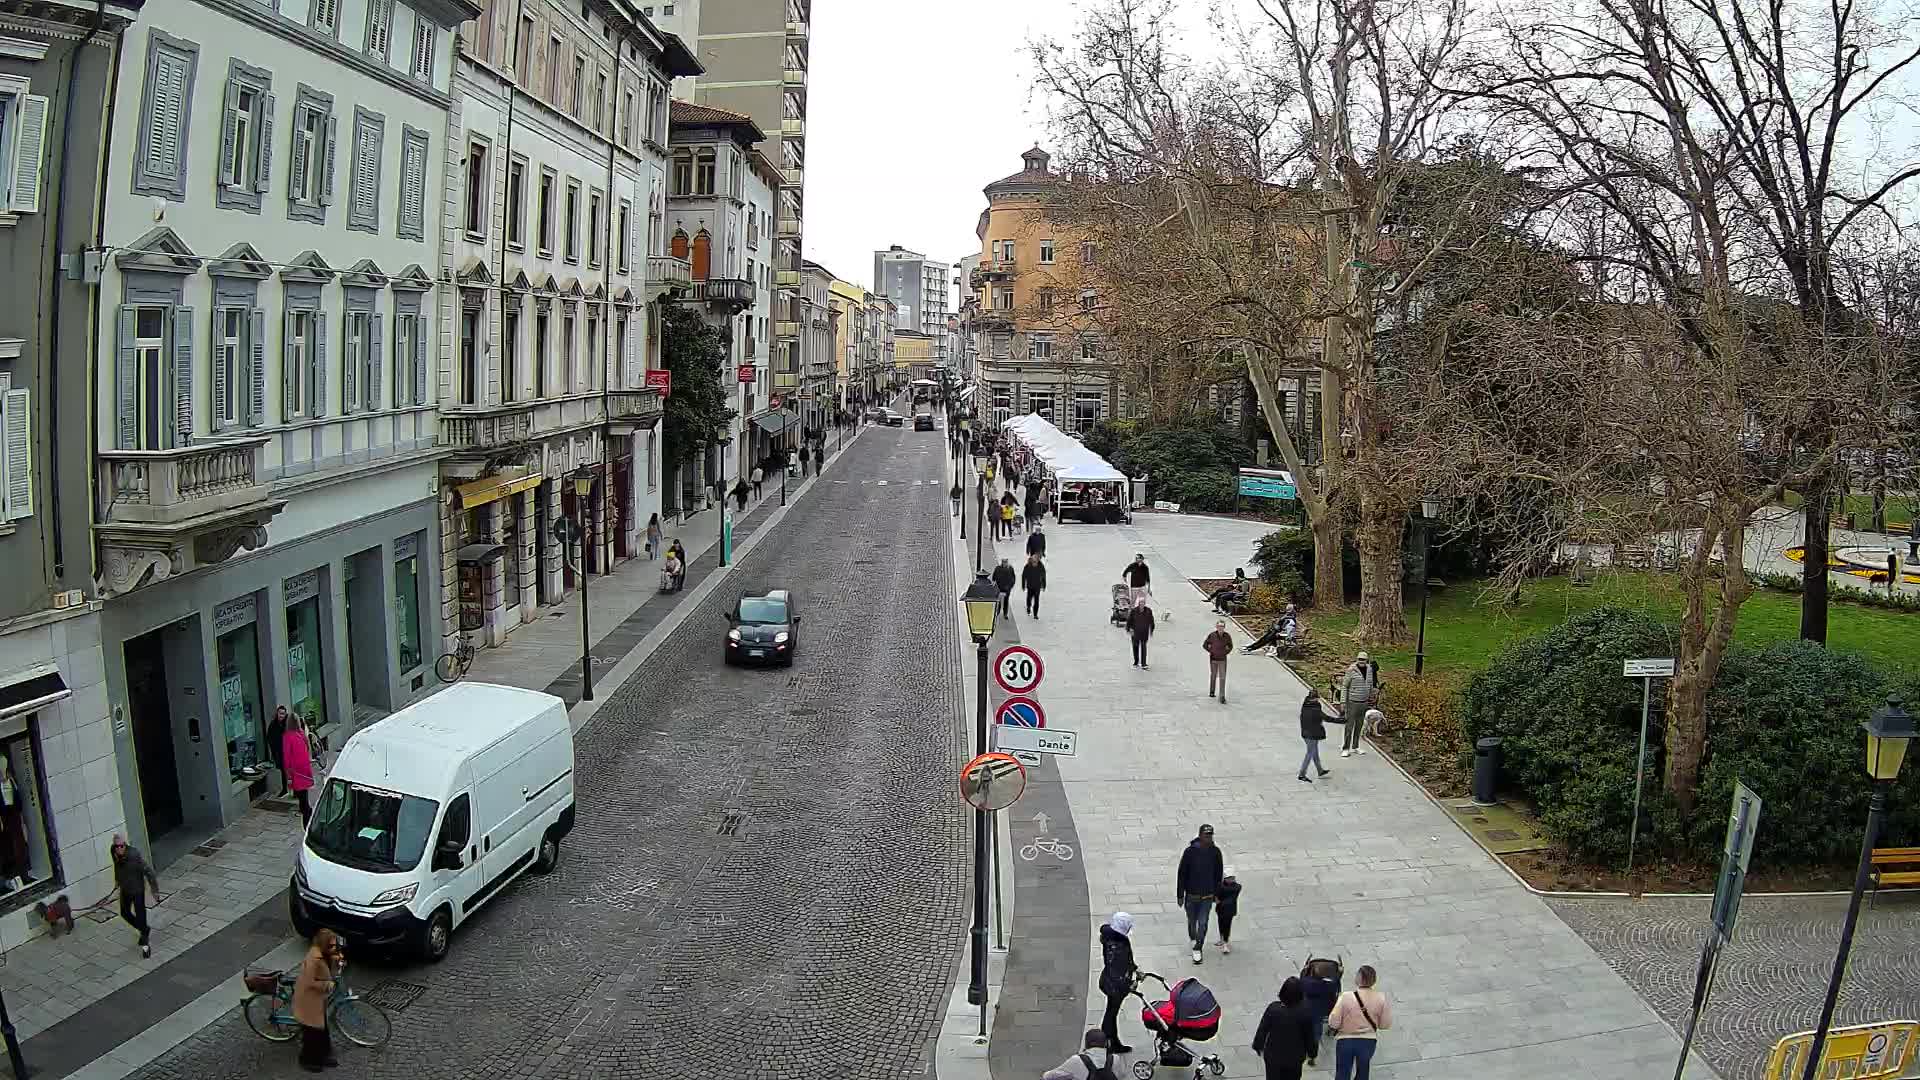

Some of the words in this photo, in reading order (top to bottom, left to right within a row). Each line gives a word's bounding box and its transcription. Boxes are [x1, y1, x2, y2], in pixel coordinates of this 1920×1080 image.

[1005, 659, 1033, 681] 30
[223, 679, 240, 701] 130
[1038, 739, 1070, 750] Dante
